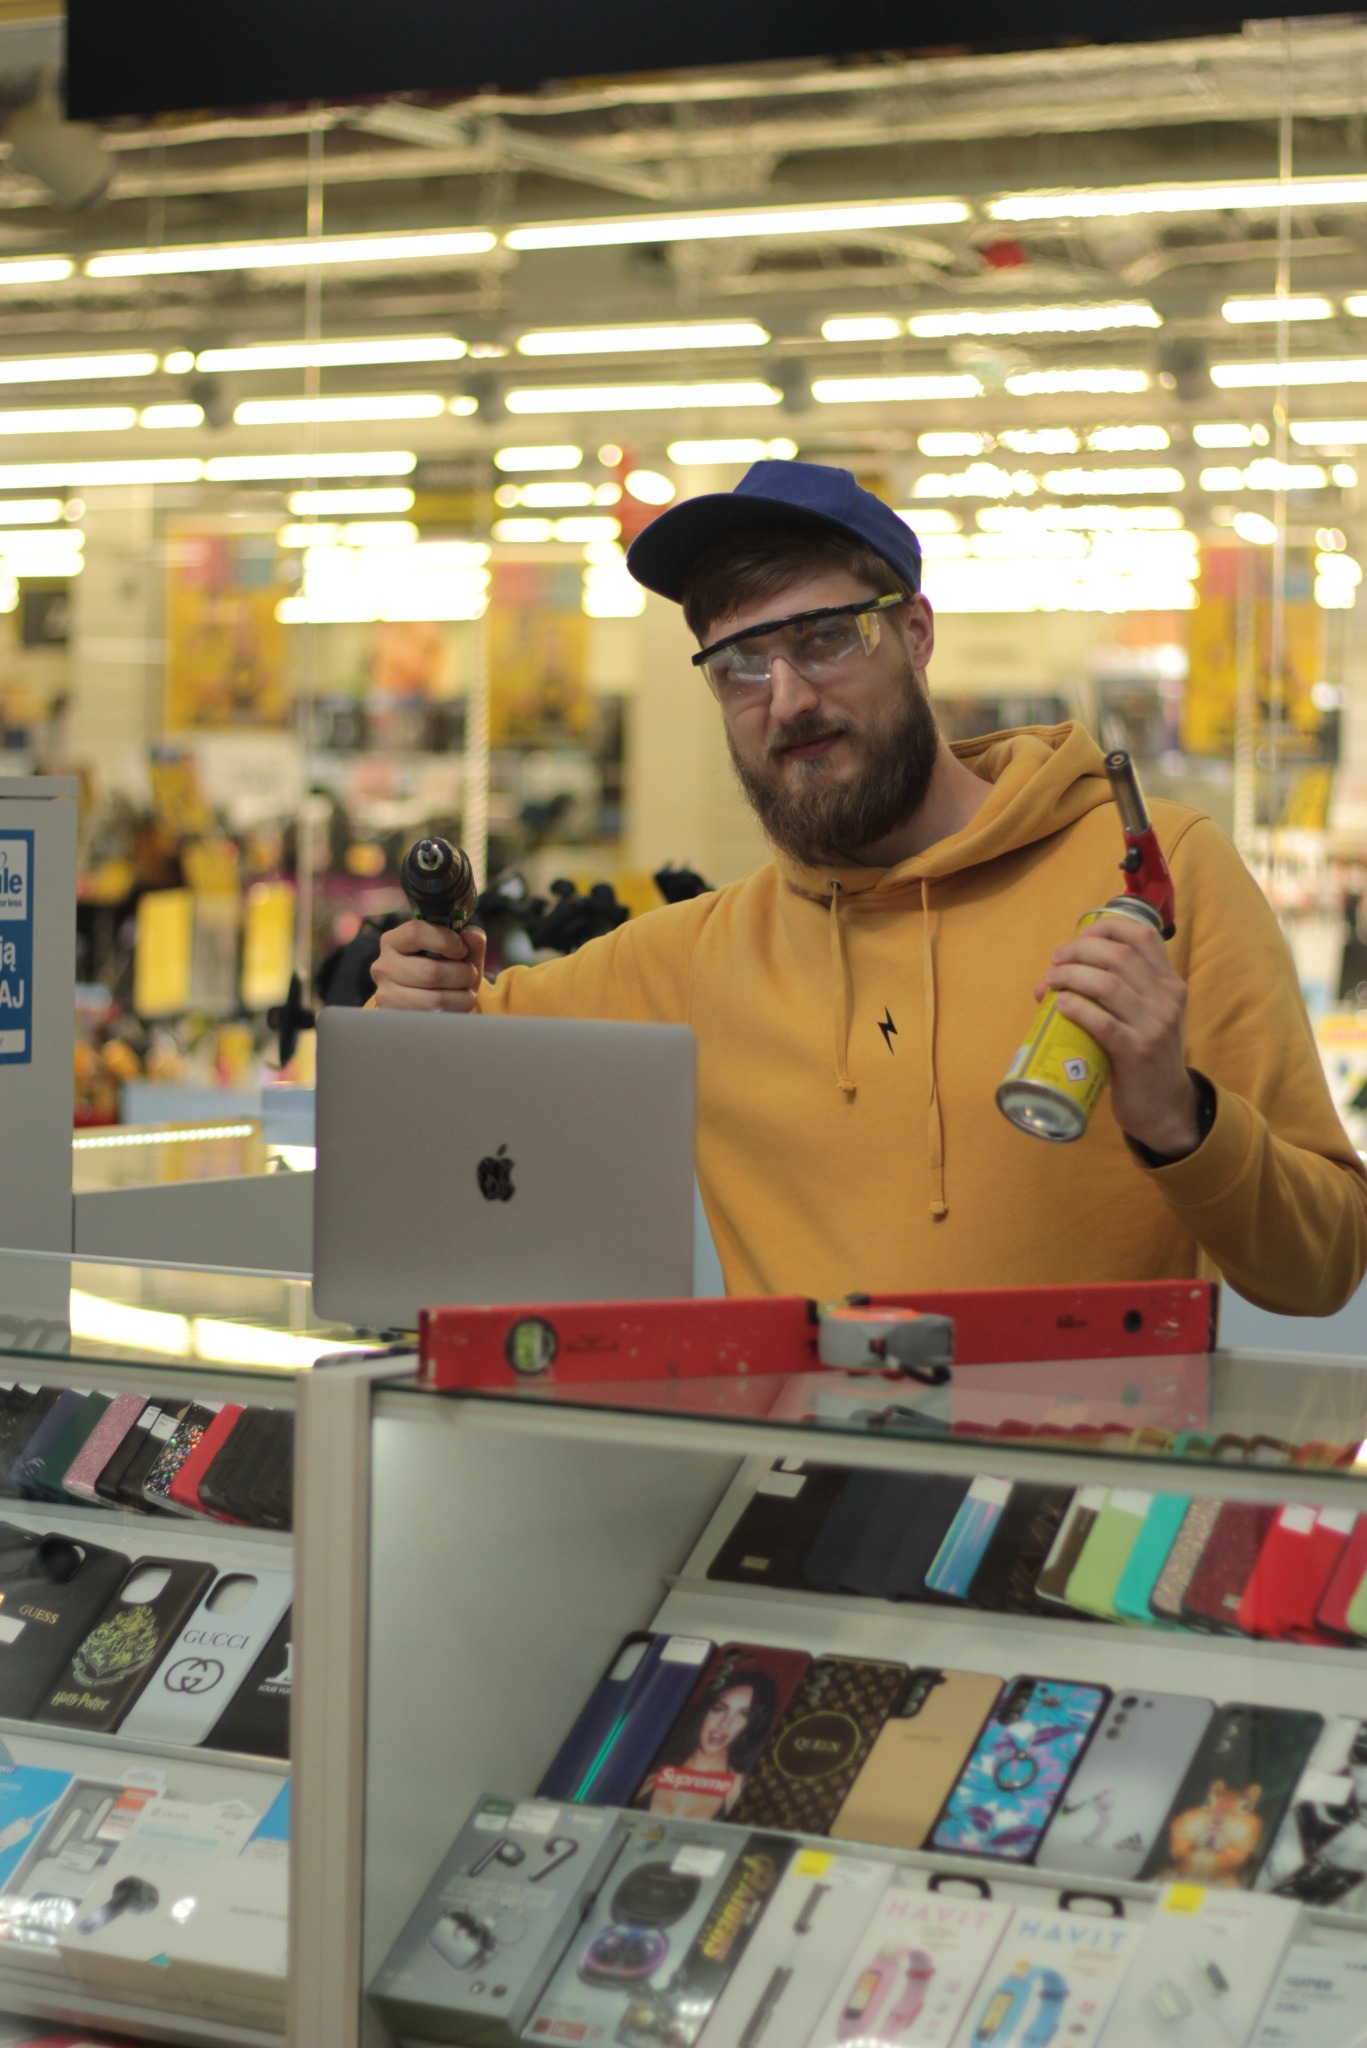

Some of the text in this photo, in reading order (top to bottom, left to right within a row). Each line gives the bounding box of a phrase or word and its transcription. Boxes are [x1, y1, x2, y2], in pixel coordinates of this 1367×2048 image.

[19, 1604, 60, 1625] GUESS
[183, 1629, 250, 1649] GUCCI
[51, 1691, 110, 1711] Harry Potter
[794, 1737, 841, 1753] QUEEN
[658, 1766, 732, 1792] Supreme
[887, 1899, 993, 1931] HAVIT
[1018, 1919, 1128, 1952] HAVIT
